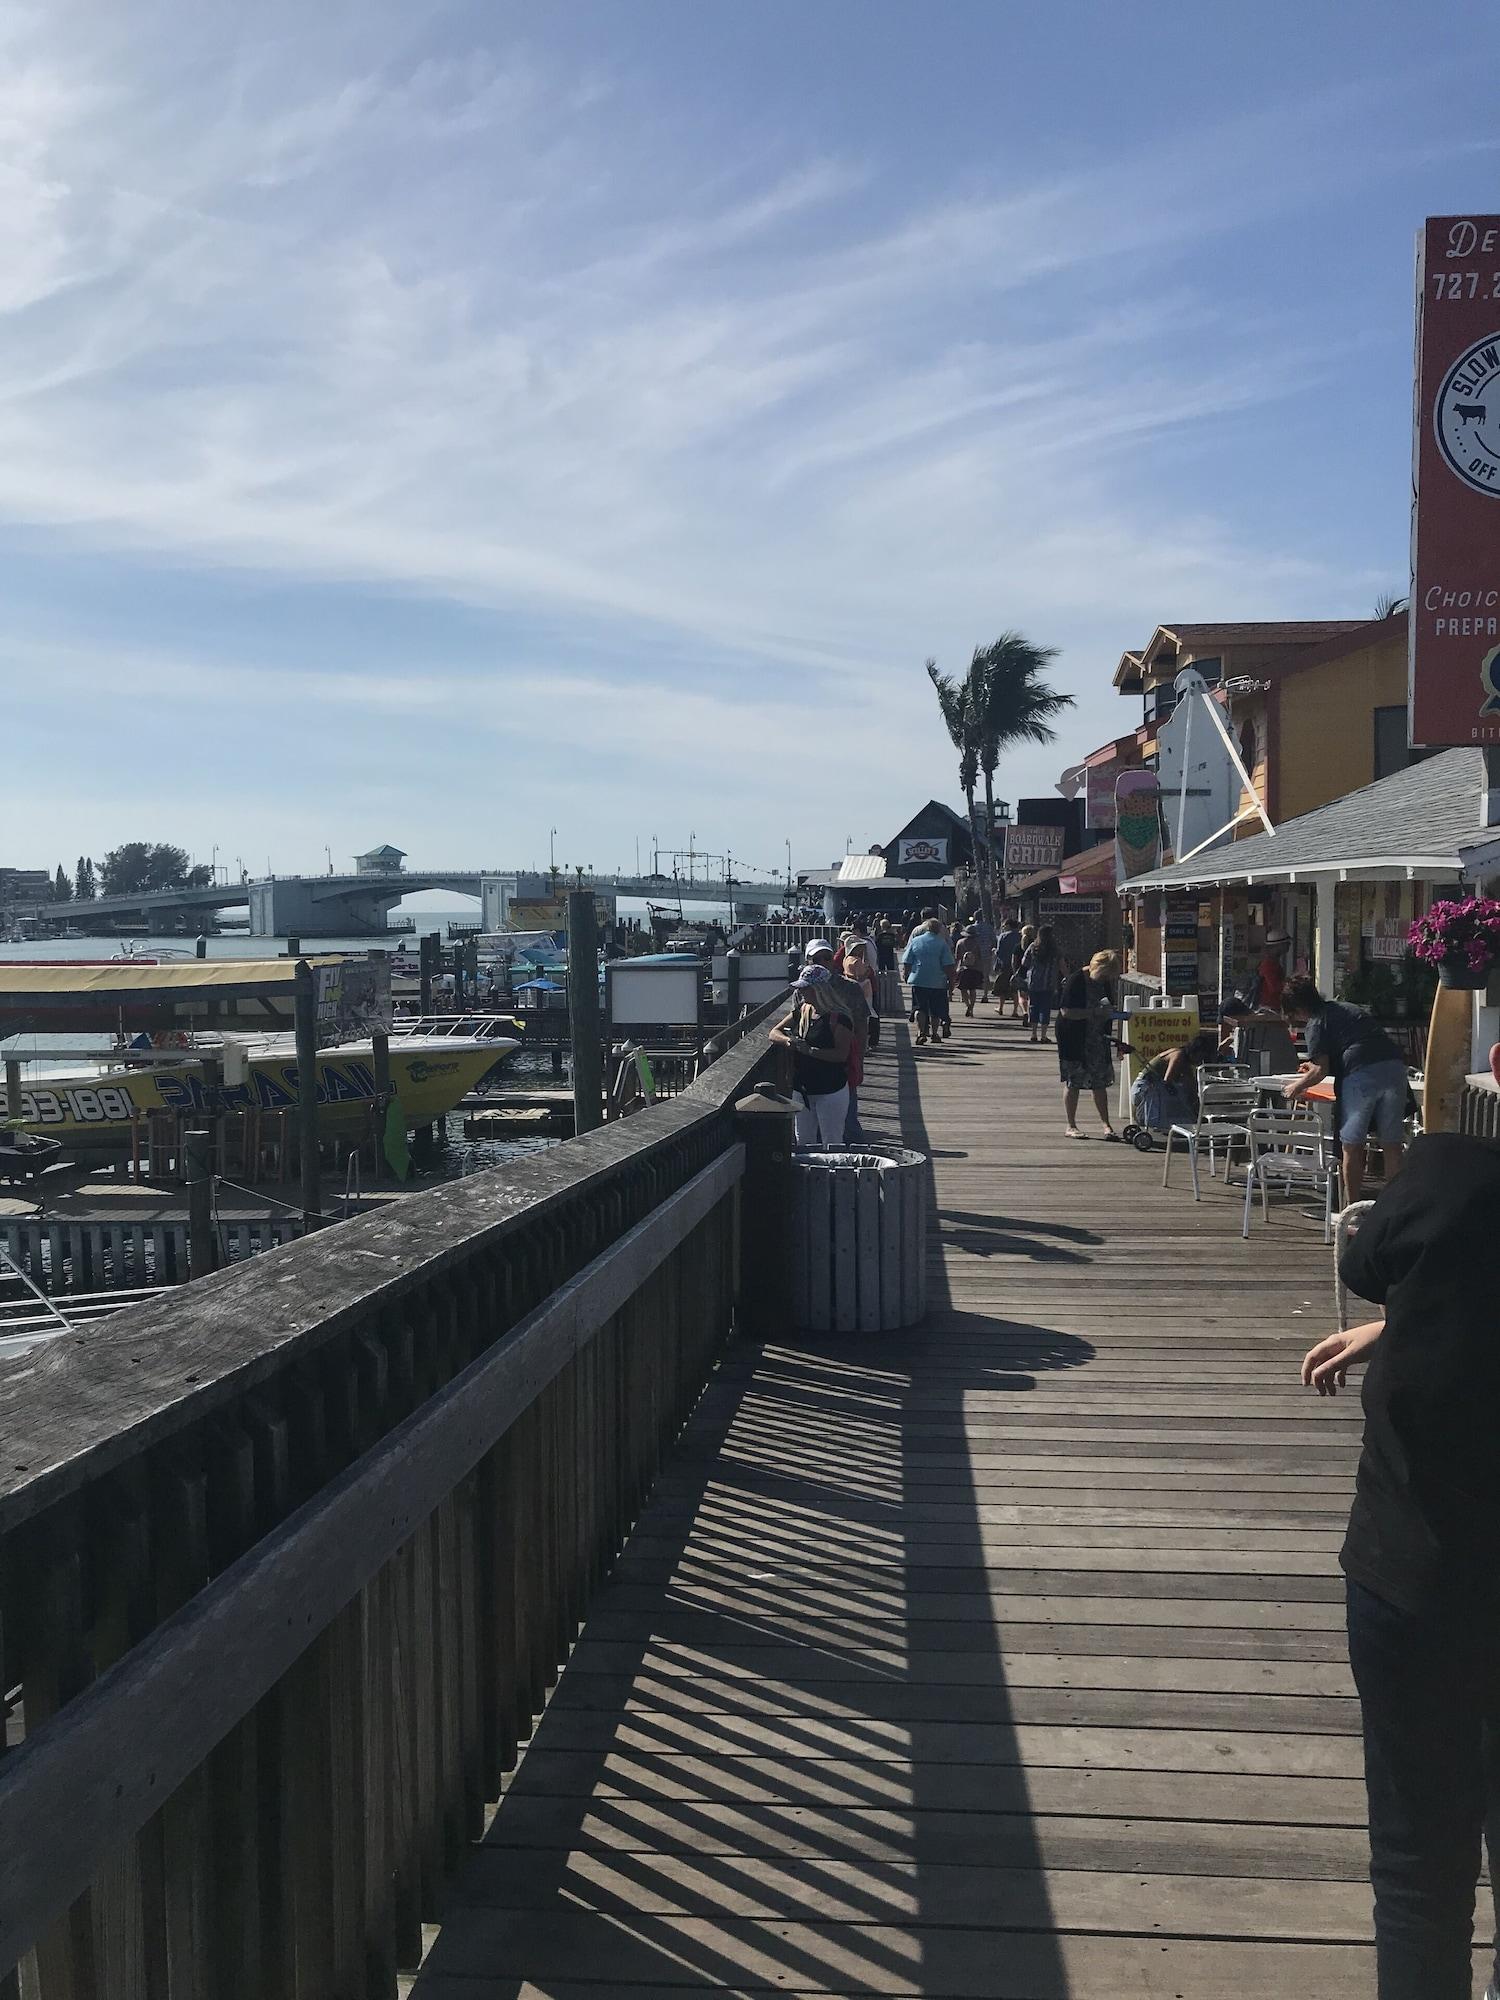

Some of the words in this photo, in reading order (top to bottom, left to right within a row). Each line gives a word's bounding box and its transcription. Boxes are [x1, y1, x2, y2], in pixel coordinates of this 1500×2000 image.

[1452, 345, 1500, 396] SLOW
[1468, 457, 1497, 480] OFF
[1472, 727, 1500, 738] BIT
[1010, 833, 1060, 846] BOARDWALK
[1008, 846, 1060, 865] GRILL
[1149, 1016, 1180, 1027] Flavors
[1181, 1016, 1191, 1027] of
[1157, 1031, 1189, 1042] Cream
